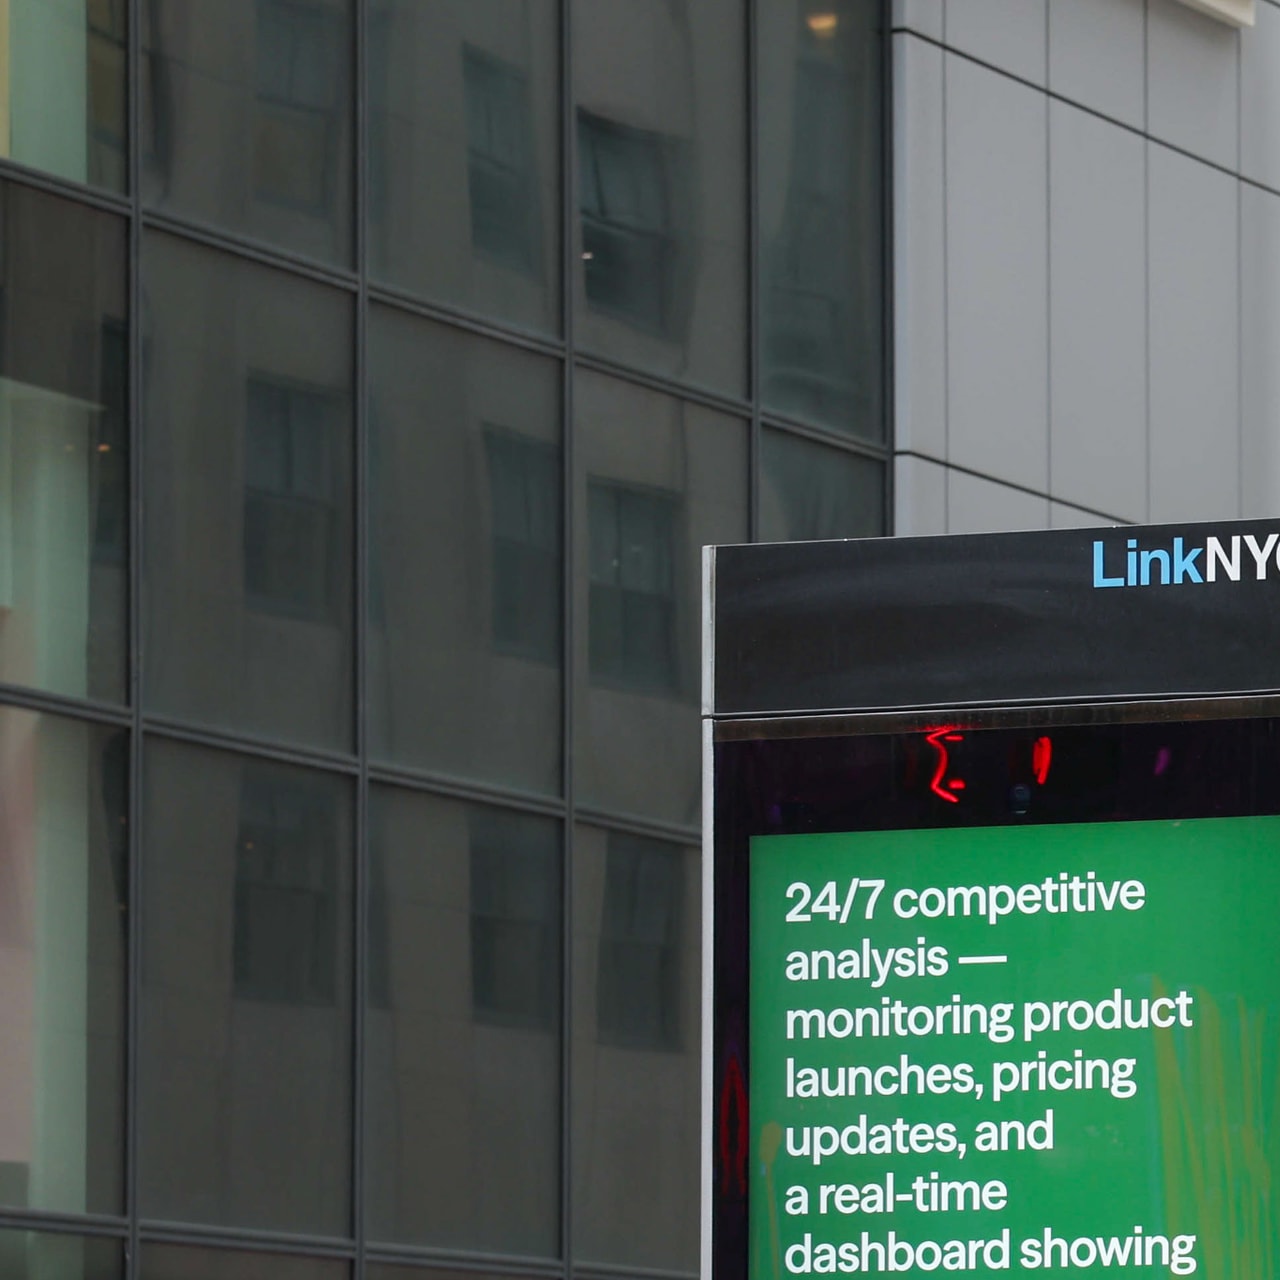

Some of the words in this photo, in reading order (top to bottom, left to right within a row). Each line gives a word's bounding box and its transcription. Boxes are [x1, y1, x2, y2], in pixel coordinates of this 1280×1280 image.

[785, 878, 885, 923] 24/7
[892, 871, 1146, 925] competitive
[785, 937, 949, 989] analysis
[786, 995, 1015, 1044] monitoring
[1023, 988, 1194, 1042] product
[786, 1055, 984, 1100] launches,
[992, 1050, 1138, 1102] pricing
[786, 1115, 967, 1166] updates,
[974, 1109, 1054, 1152] and
[785, 1185, 809, 1216] a
[819, 1171, 1008, 1214] real-time
[784, 1229, 1010, 1274] dashboard
[1019, 1225, 1197, 1276] showing
